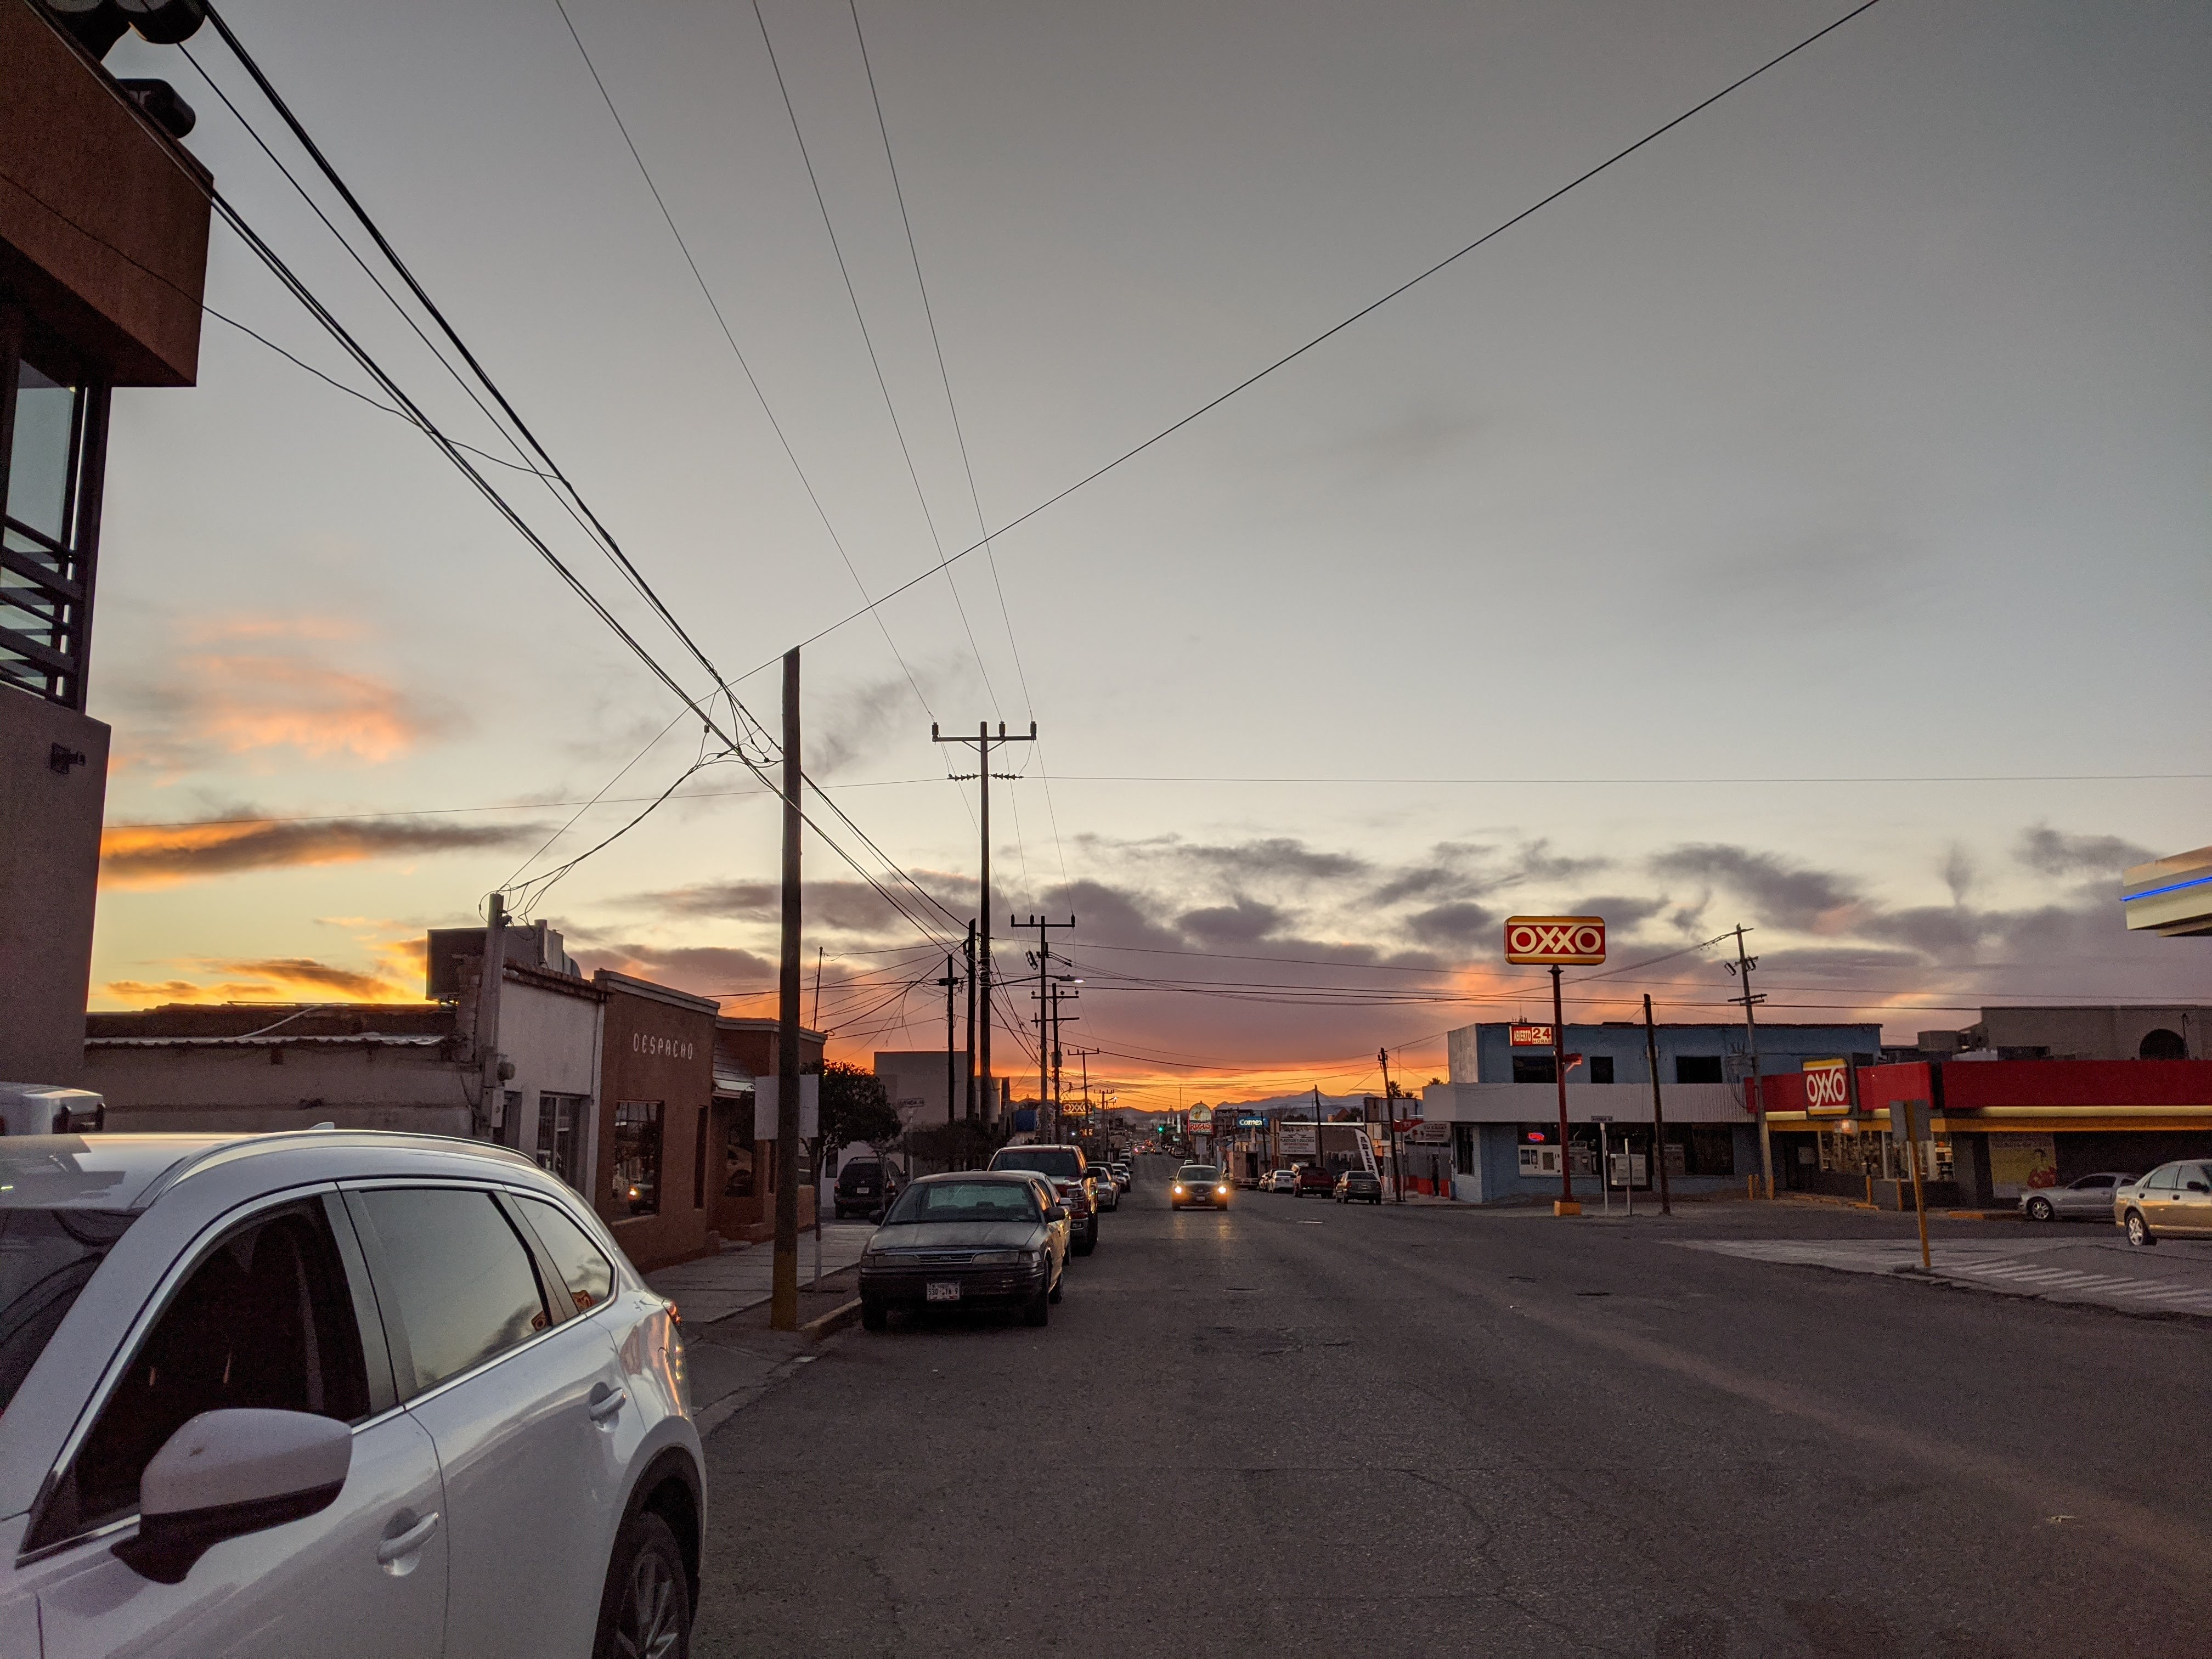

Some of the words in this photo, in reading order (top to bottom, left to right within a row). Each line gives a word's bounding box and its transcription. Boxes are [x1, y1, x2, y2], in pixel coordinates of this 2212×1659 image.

[1511, 926, 1601, 953] OXXO
[1514, 1030, 1531, 1042] ABIERTO
[1533, 1028, 1551, 1039] 24
[633, 1032, 693, 1060] DESPACHO
[1806, 1071, 1846, 1104] OXXO
[1063, 1102, 1092, 1112] OXXO
